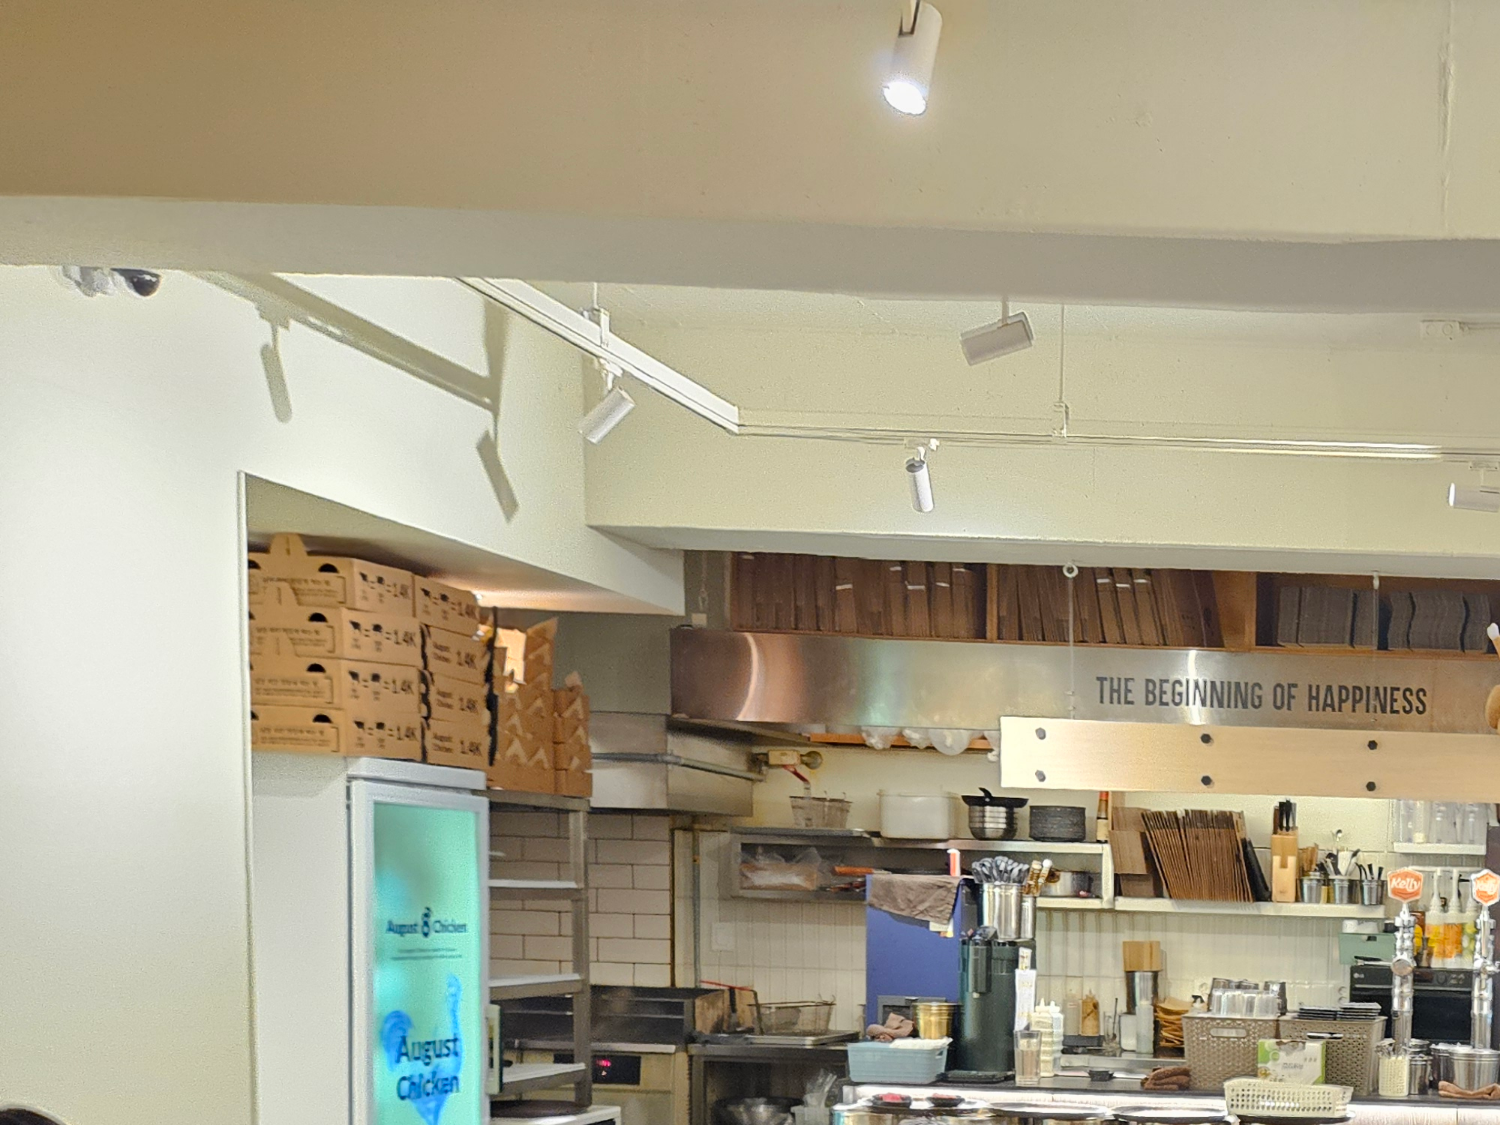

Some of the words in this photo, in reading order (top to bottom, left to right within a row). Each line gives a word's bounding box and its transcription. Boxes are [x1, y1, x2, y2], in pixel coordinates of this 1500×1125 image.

[1095, 676, 1135, 706] THE
[1144, 678, 1263, 710] BEGINNING
[1272, 682, 1298, 711] OF
[1307, 684, 1427, 715] HAPPINESS
[1390, 877, 1421, 892] Kelly
[395, 1033, 460, 1066] August
[396, 1071, 460, 1101] Chicken
